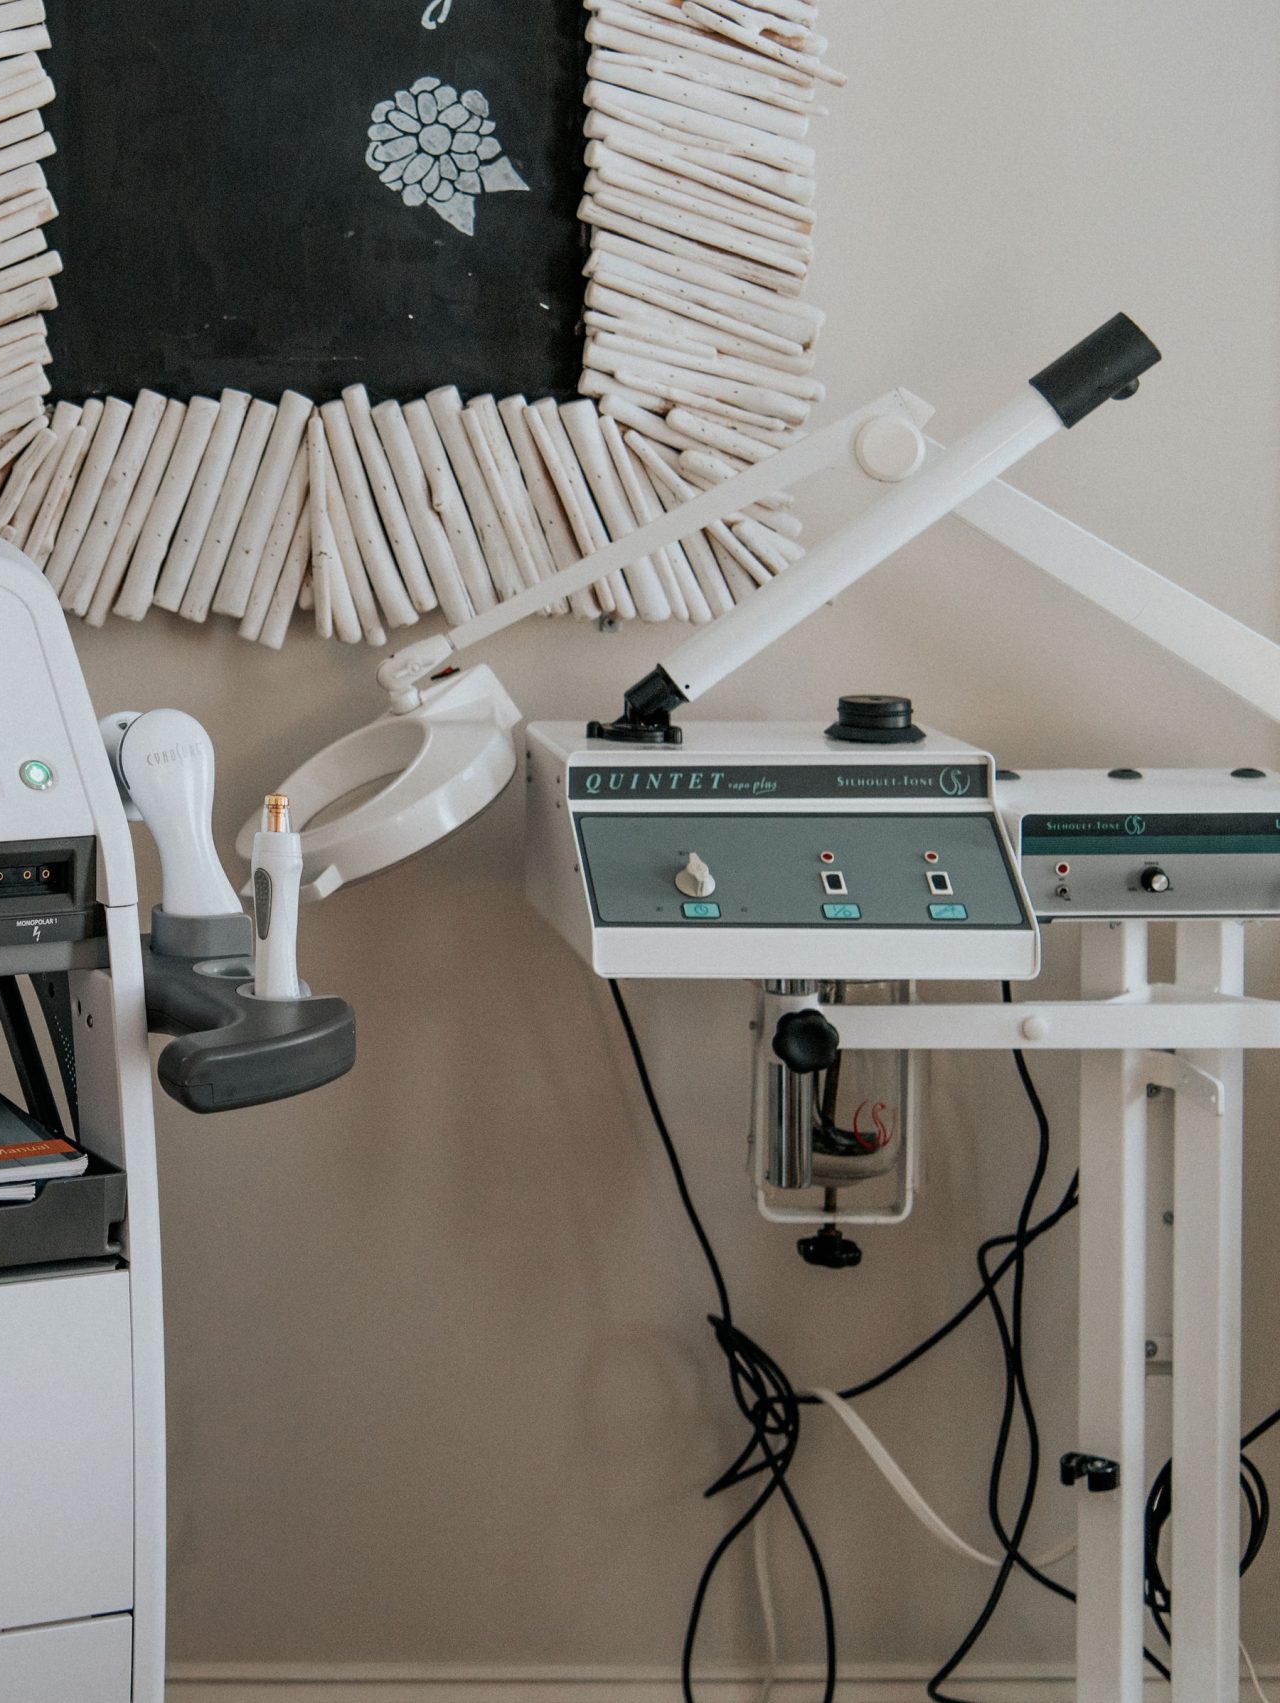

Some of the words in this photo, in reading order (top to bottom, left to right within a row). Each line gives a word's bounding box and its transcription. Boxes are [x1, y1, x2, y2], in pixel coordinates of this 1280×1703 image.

[585, 772, 725, 794] QUINTET
[752, 777, 778, 796] plus
[16, 917, 54, 927] MONOPOLAR
